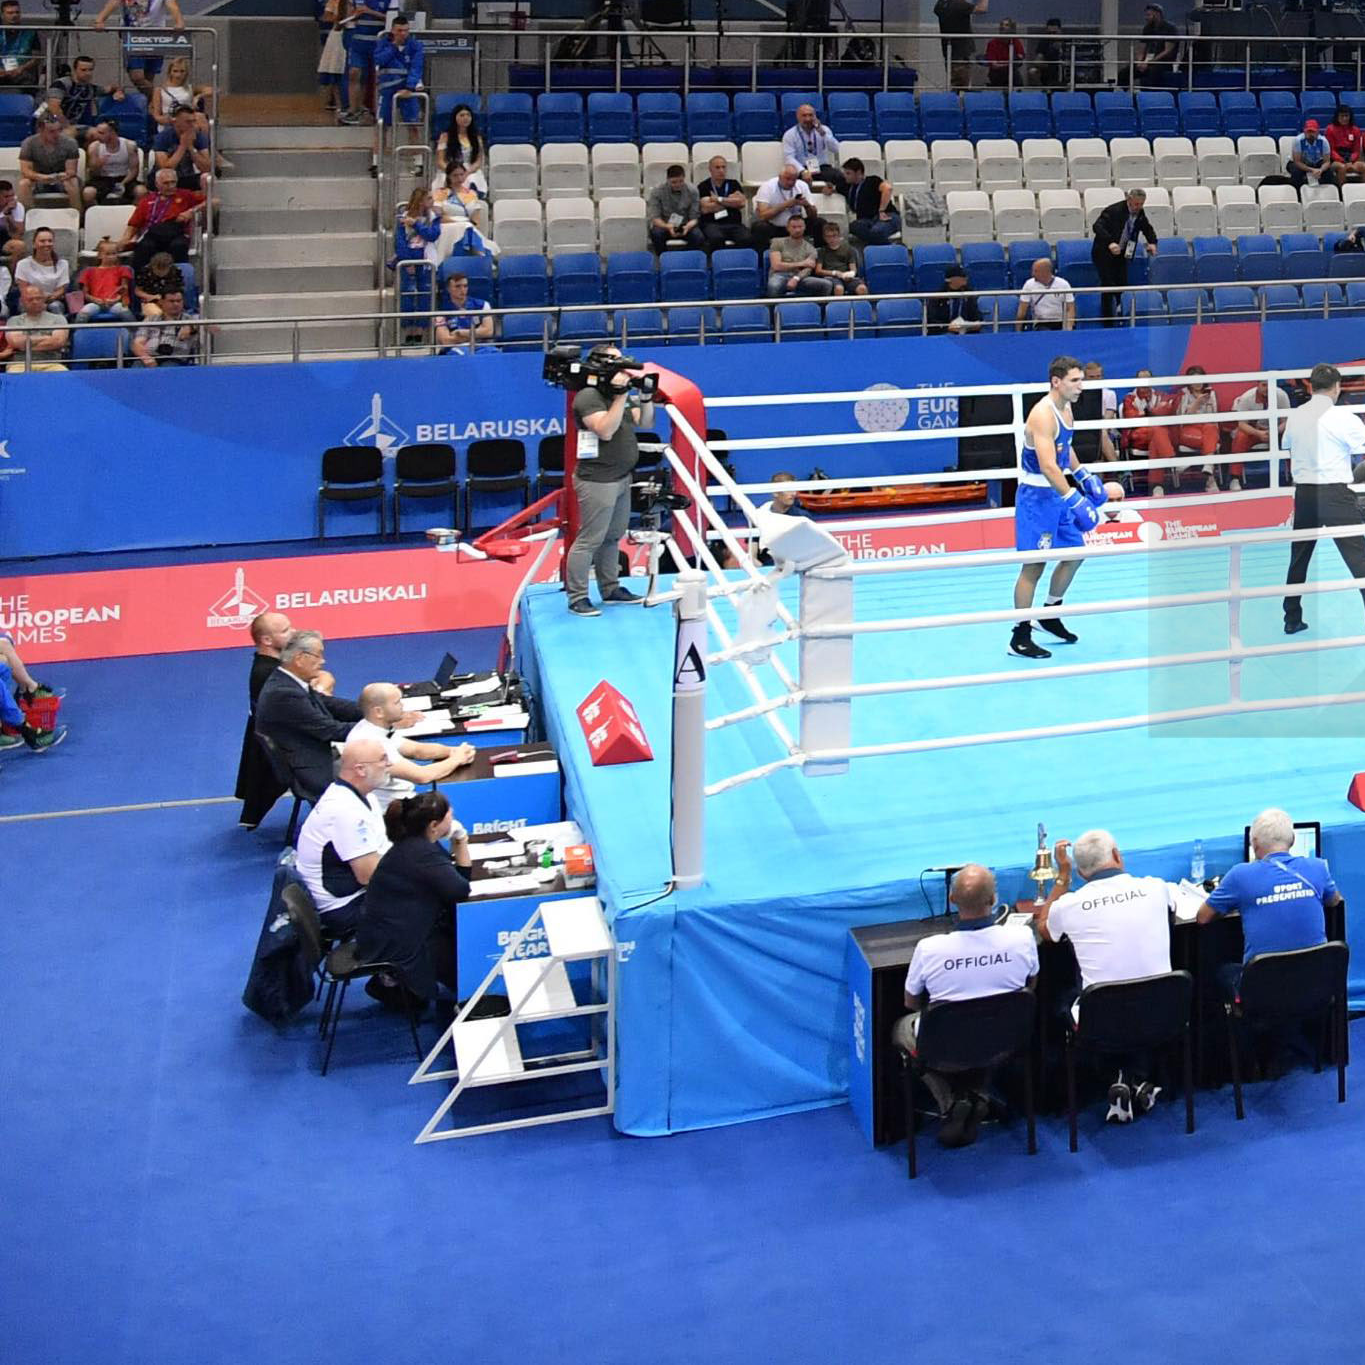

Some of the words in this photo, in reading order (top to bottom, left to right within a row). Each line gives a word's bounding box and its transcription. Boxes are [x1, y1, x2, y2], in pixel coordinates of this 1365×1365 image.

[416, 417, 567, 443] BELARUSKA
[917, 414, 958, 431] GAM
[849, 543, 946, 562] UROPEAN
[275, 583, 428, 610] BELARUSKALI
[0, 604, 121, 629] UROPEAN
[674, 642, 706, 684] A
[1081, 888, 1148, 912] OFFICIAL
[944, 952, 1012, 971] OFFICIAL
